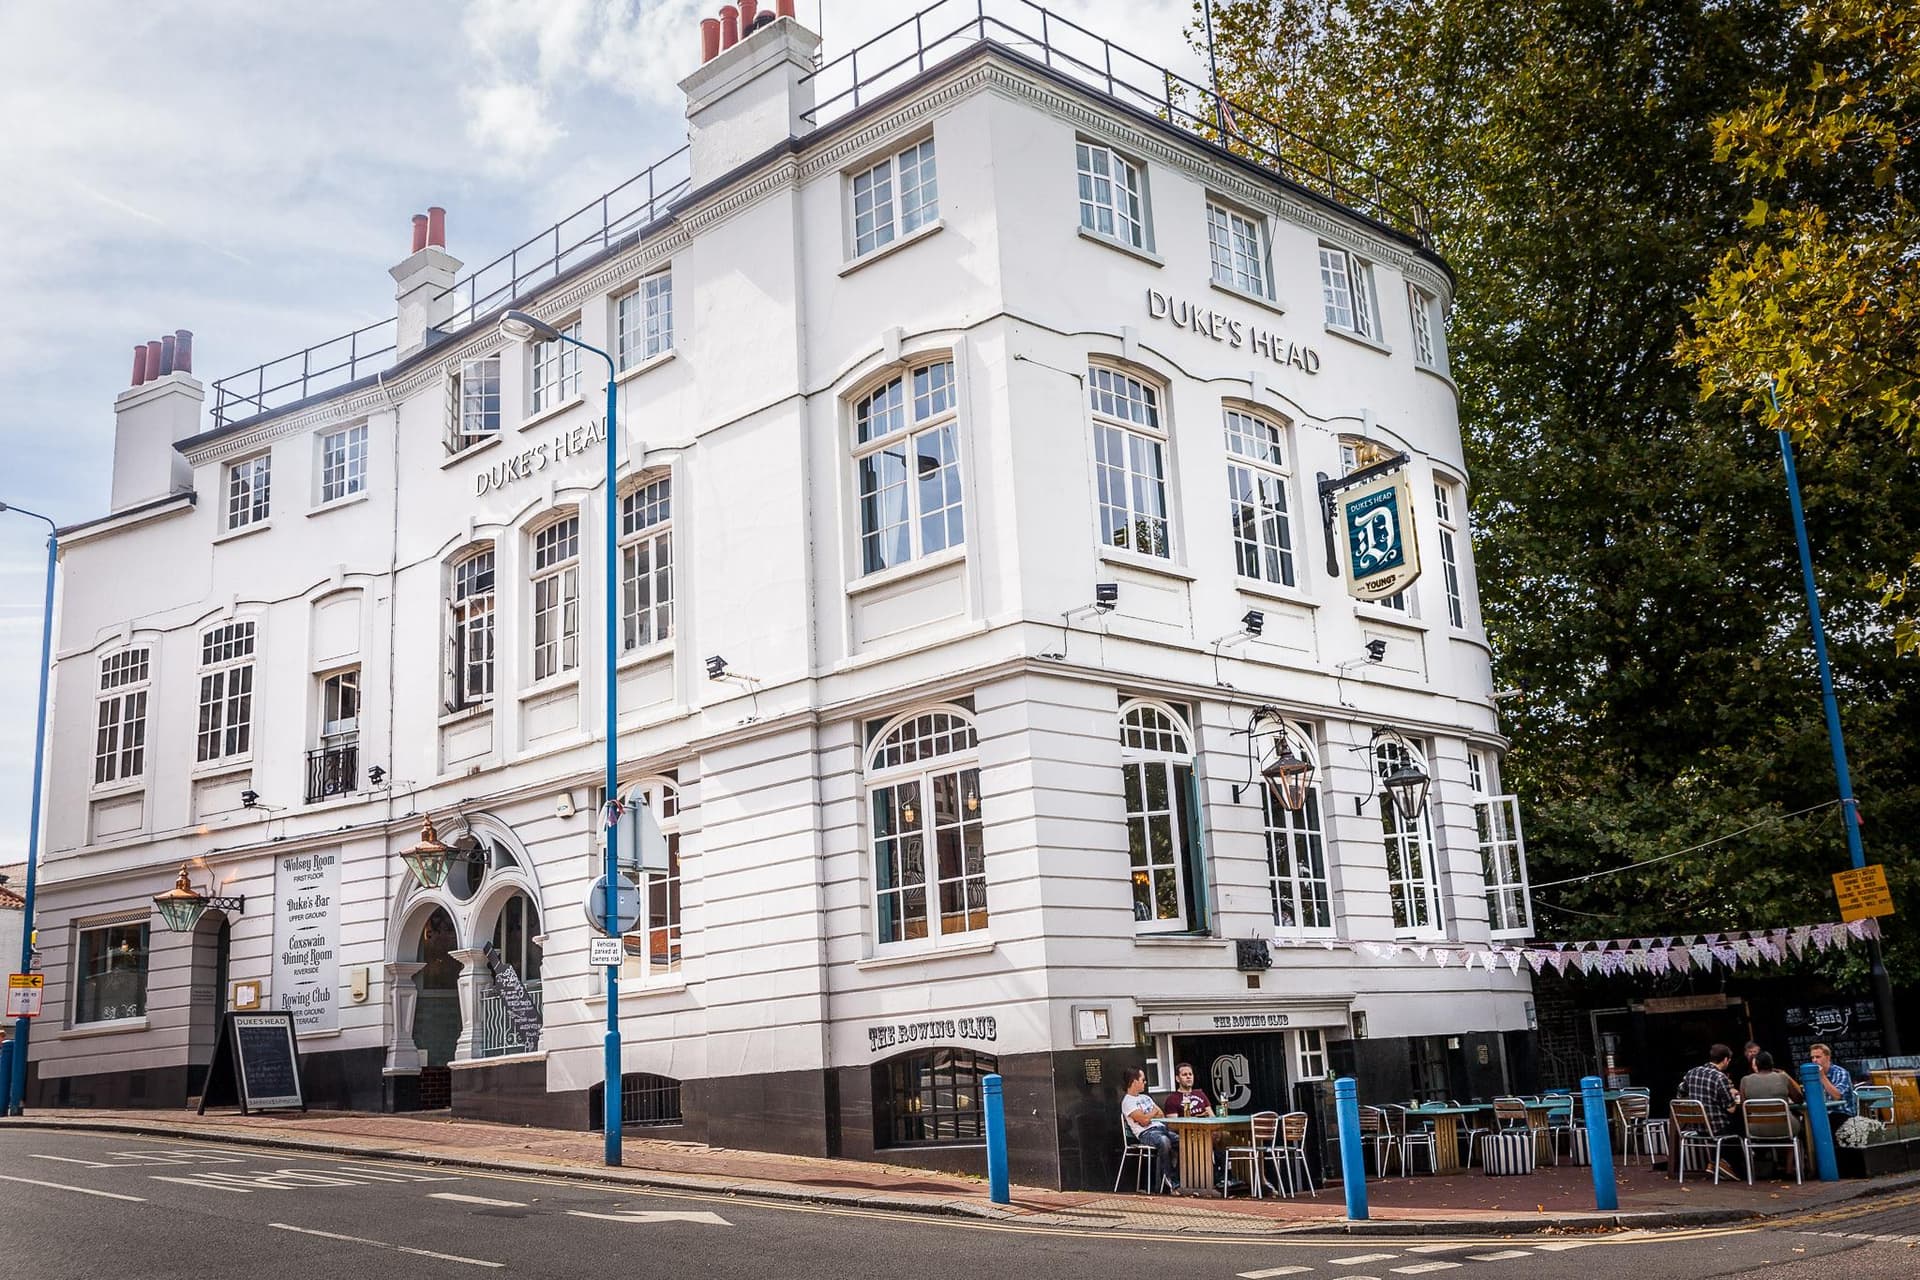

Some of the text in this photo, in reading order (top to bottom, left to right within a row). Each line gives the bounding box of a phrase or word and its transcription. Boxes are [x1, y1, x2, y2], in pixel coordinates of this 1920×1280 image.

[1148, 288, 1321, 376] DUKE'S HEAD
[476, 443, 547, 497] DUKE'S
[1350, 492, 1392, 512] DUKE'S HEAD
[1354, 506, 1396, 568] D
[1366, 575, 1396, 590] YOUNG'S
[284, 855, 334, 872] Wolsey Room
[294, 872, 324, 882] FIRST FLOOR
[287, 894, 330, 912] Duke's Bar
[305, 911, 326, 920] GROUND
[289, 934, 325, 950] Coxswain
[282, 949, 332, 966] Dining Room
[294, 967, 319, 976] RIVERSIDE
[282, 987, 330, 1010] Rowing Club
[304, 1008, 325, 1016] GROUND
[1214, 1014, 1288, 1028] THE ROWING CLUB
[868, 1016, 997, 1052] THE ROWING CLUB
[1211, 1054, 1251, 1110] C
